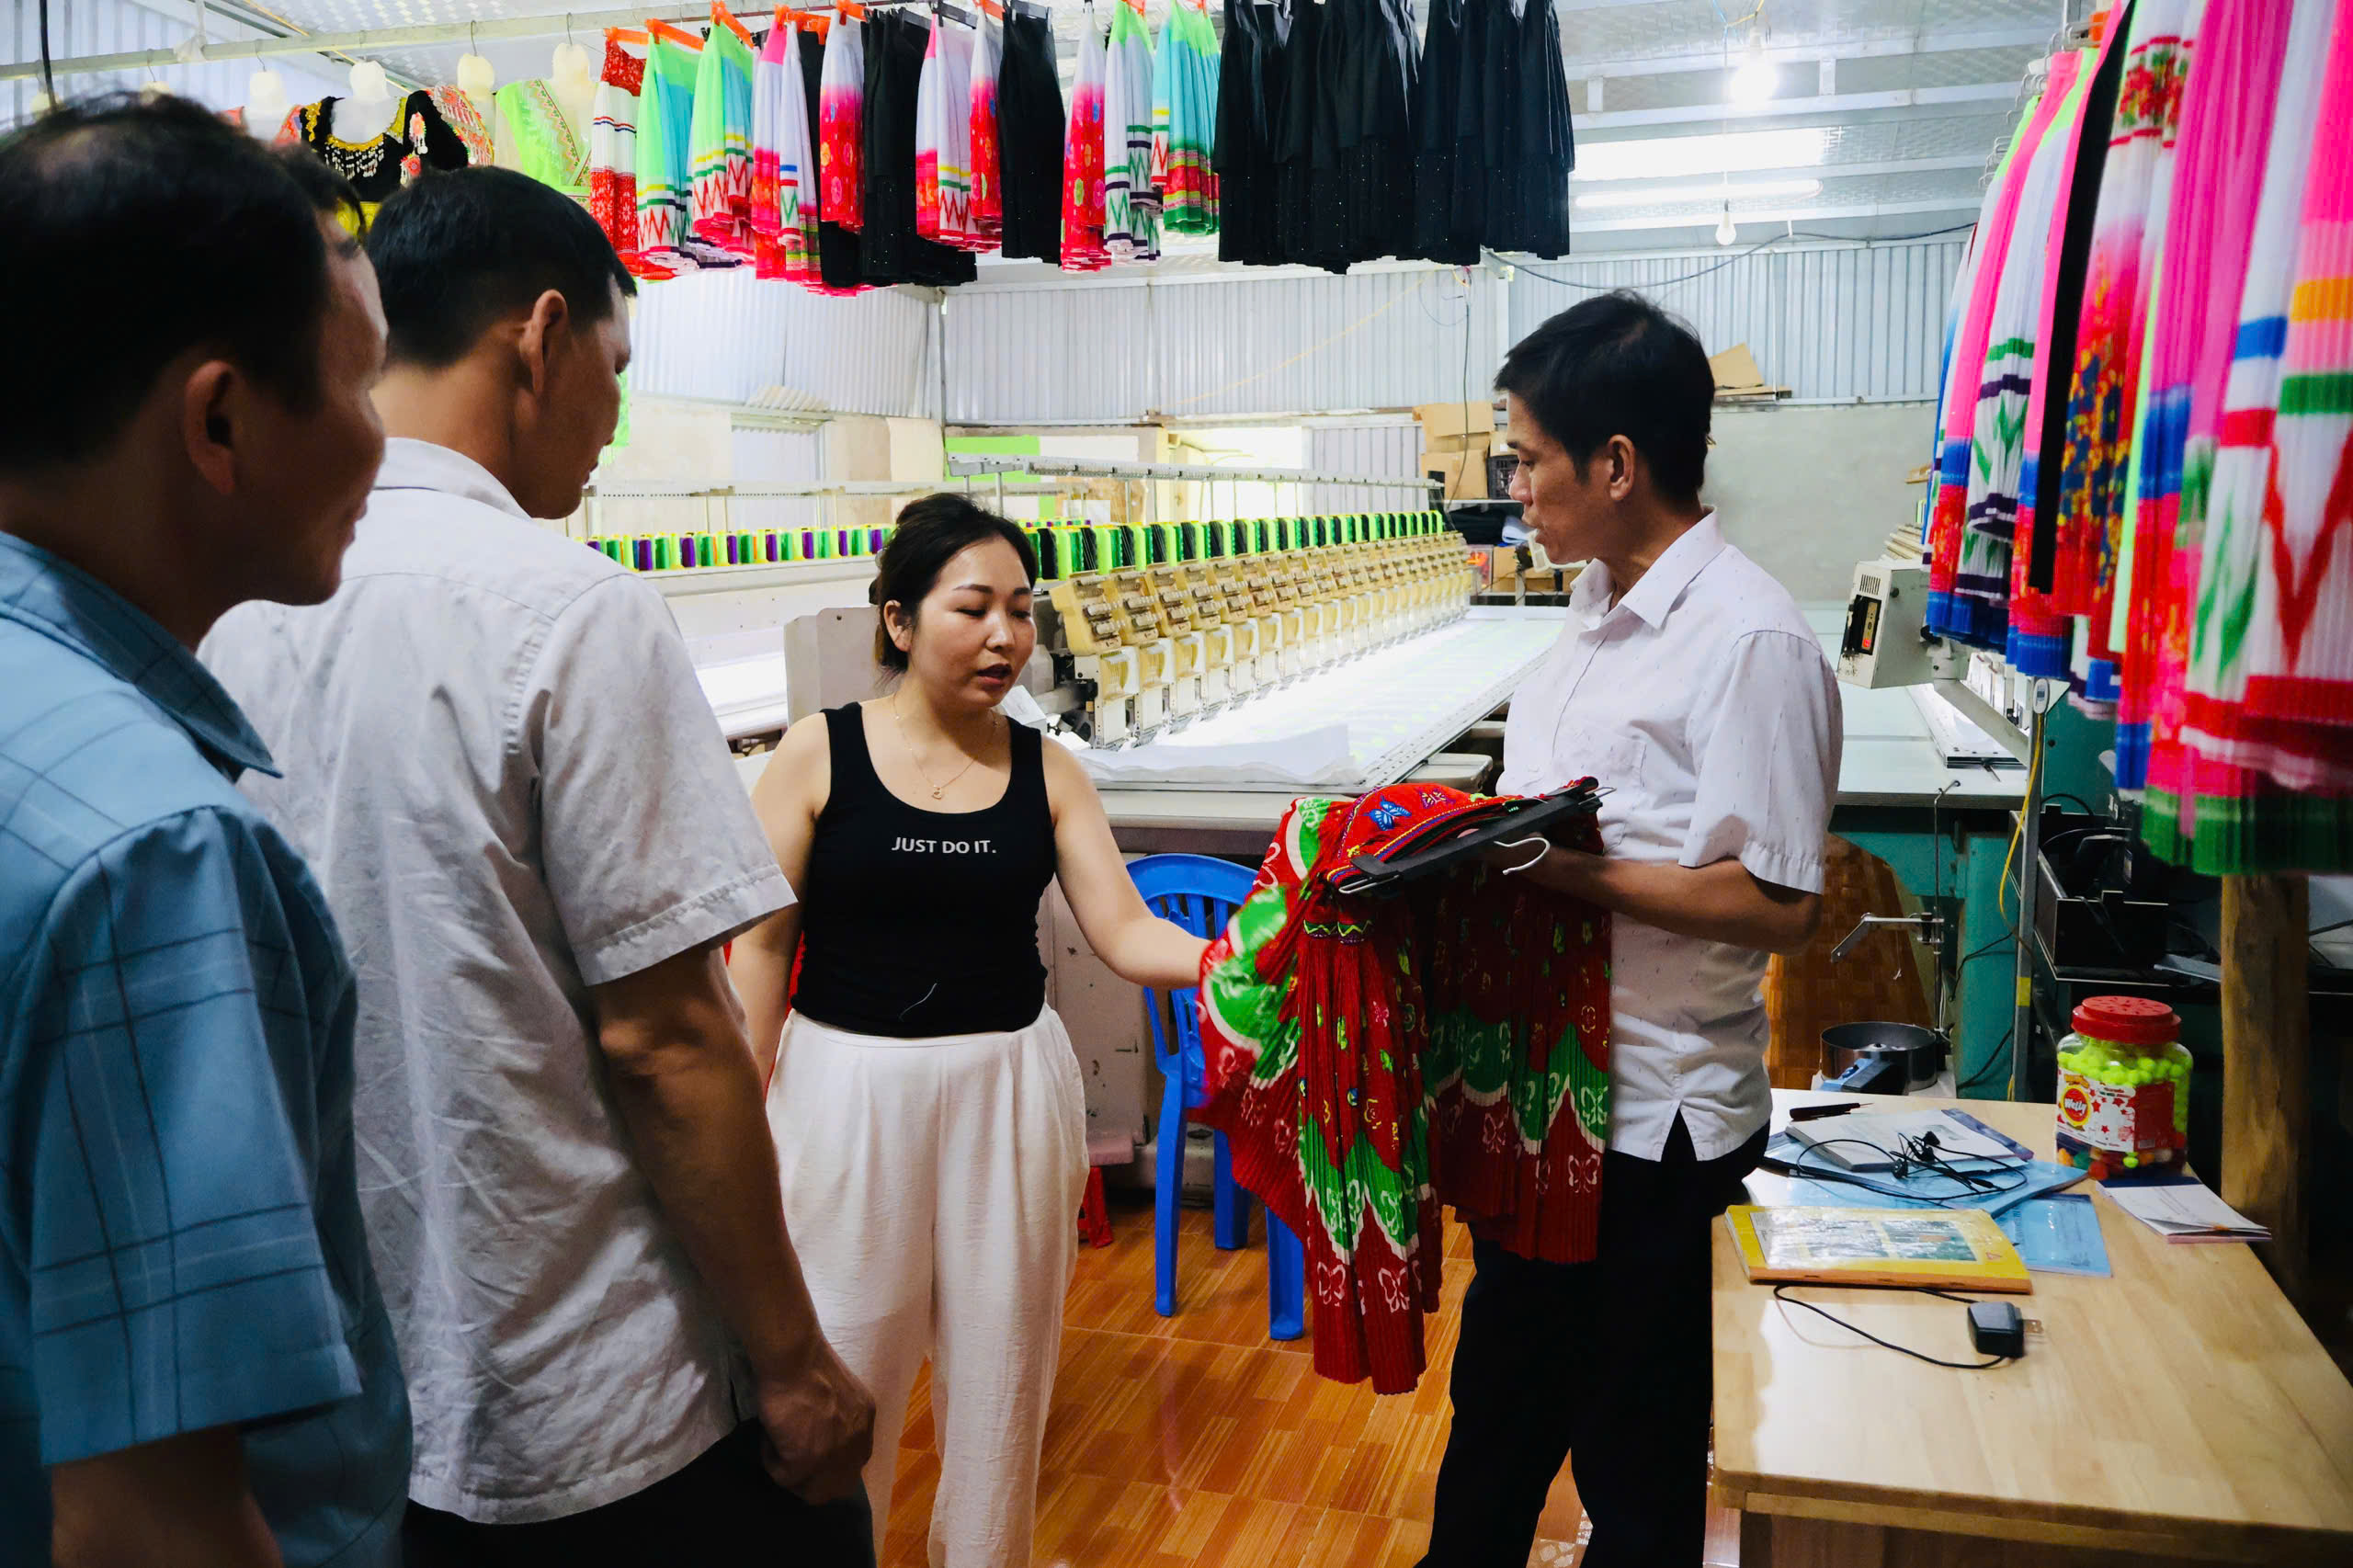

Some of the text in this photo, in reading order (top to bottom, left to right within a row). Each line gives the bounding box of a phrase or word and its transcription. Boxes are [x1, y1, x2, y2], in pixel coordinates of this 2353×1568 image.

[891, 836, 996, 854] JUST DO IT.
